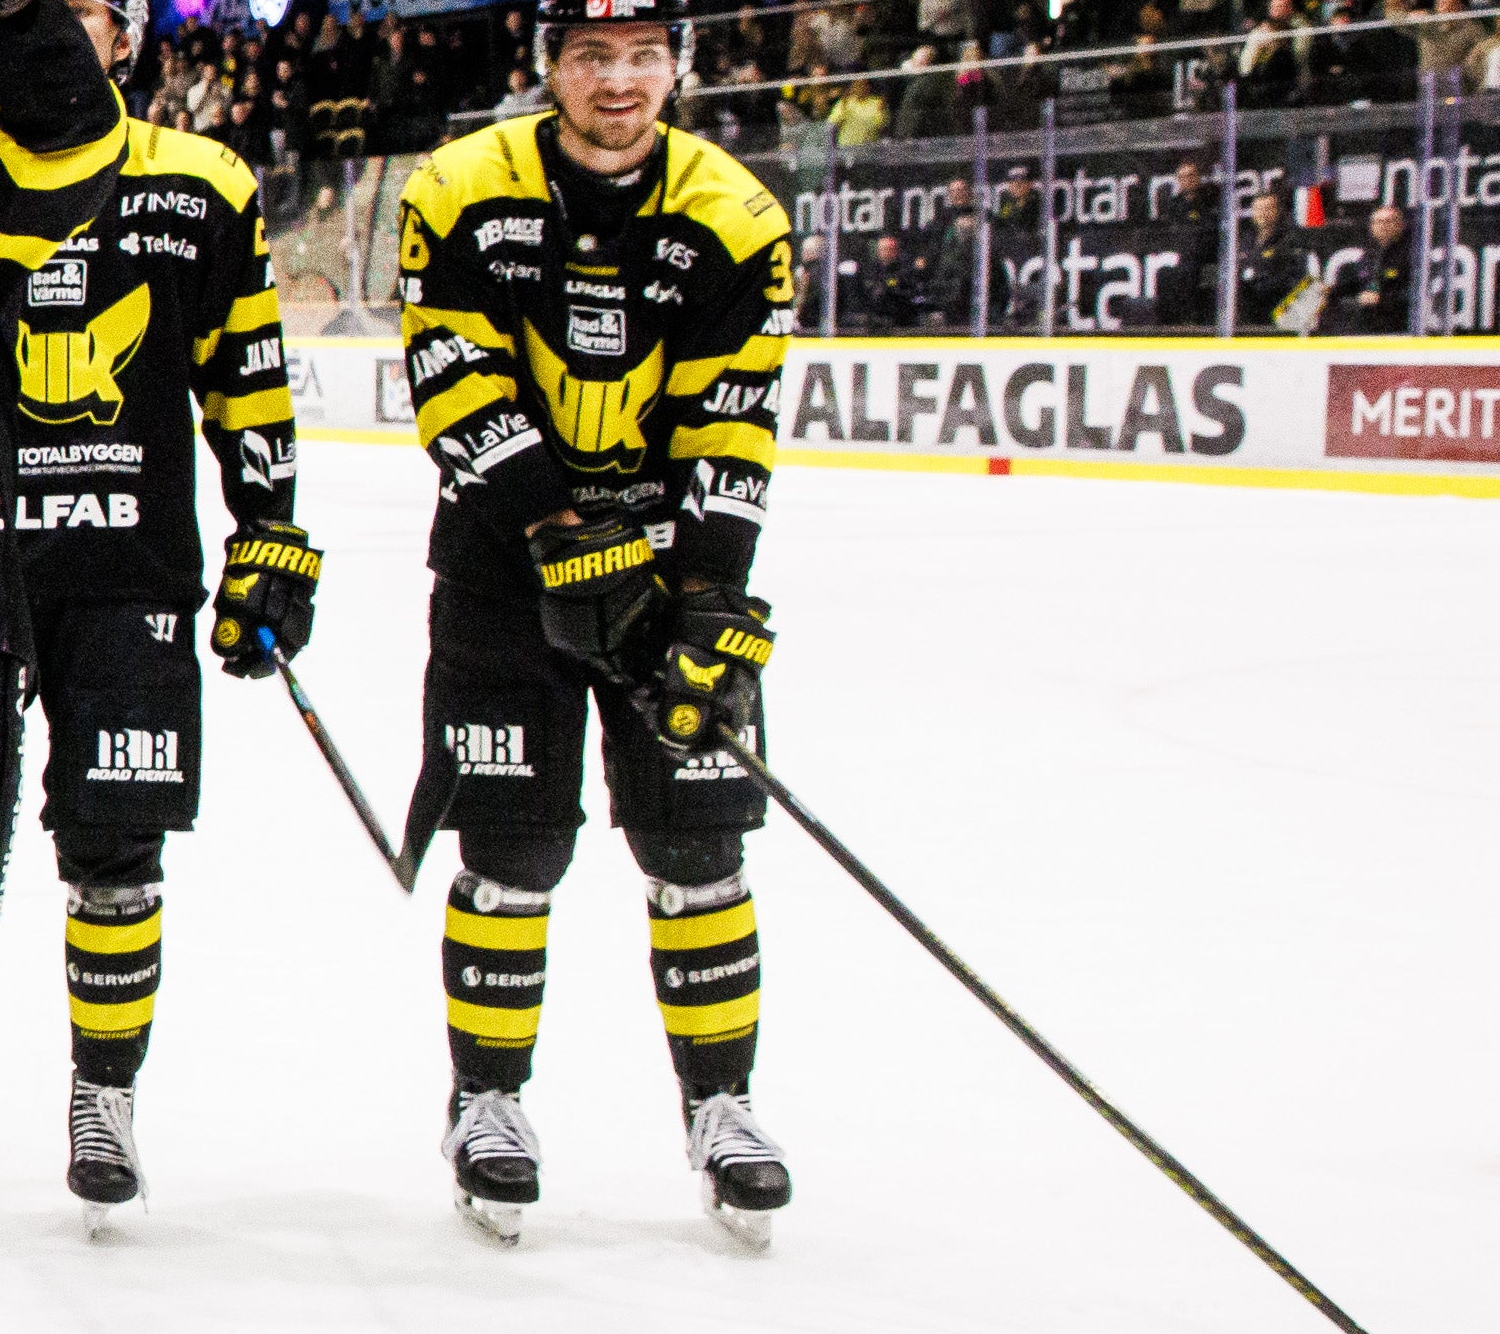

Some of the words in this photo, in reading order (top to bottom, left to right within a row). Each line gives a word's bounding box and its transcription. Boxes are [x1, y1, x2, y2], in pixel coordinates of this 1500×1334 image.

[795, 181, 892, 235] notar
[463, 409, 531, 454] LaVie
[792, 362, 1247, 456] ALFAGLAS
[85, 767, 132, 782] ROAD
[134, 767, 185, 783] RENTAL
[81, 963, 159, 985] SERWENT
